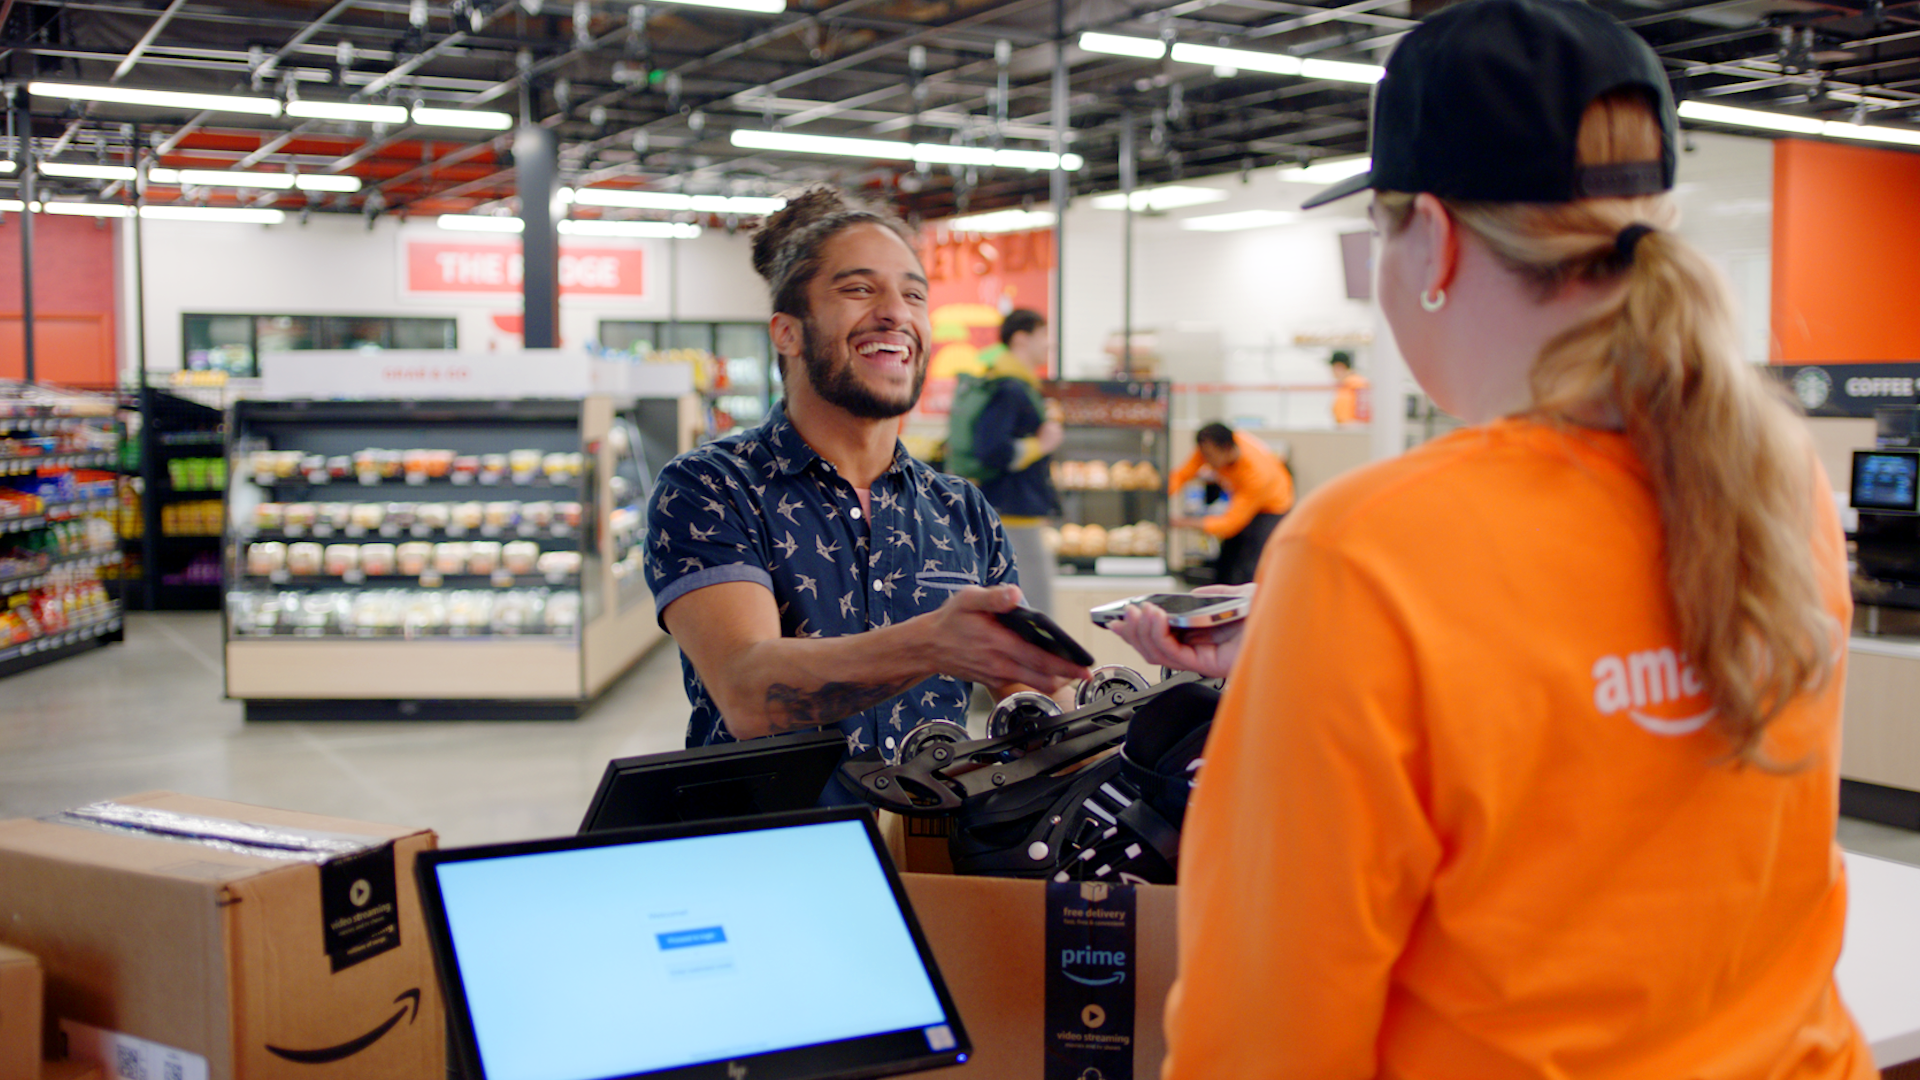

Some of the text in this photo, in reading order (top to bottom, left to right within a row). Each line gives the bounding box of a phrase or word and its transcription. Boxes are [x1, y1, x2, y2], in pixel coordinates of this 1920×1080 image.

[436, 252, 505, 284] THE
[1845, 377, 1914, 397] COFFEE
[1063, 907, 1126, 921] free delivery
[1061, 945, 1127, 969] prime
[1057, 1031, 1130, 1046] video streaming
